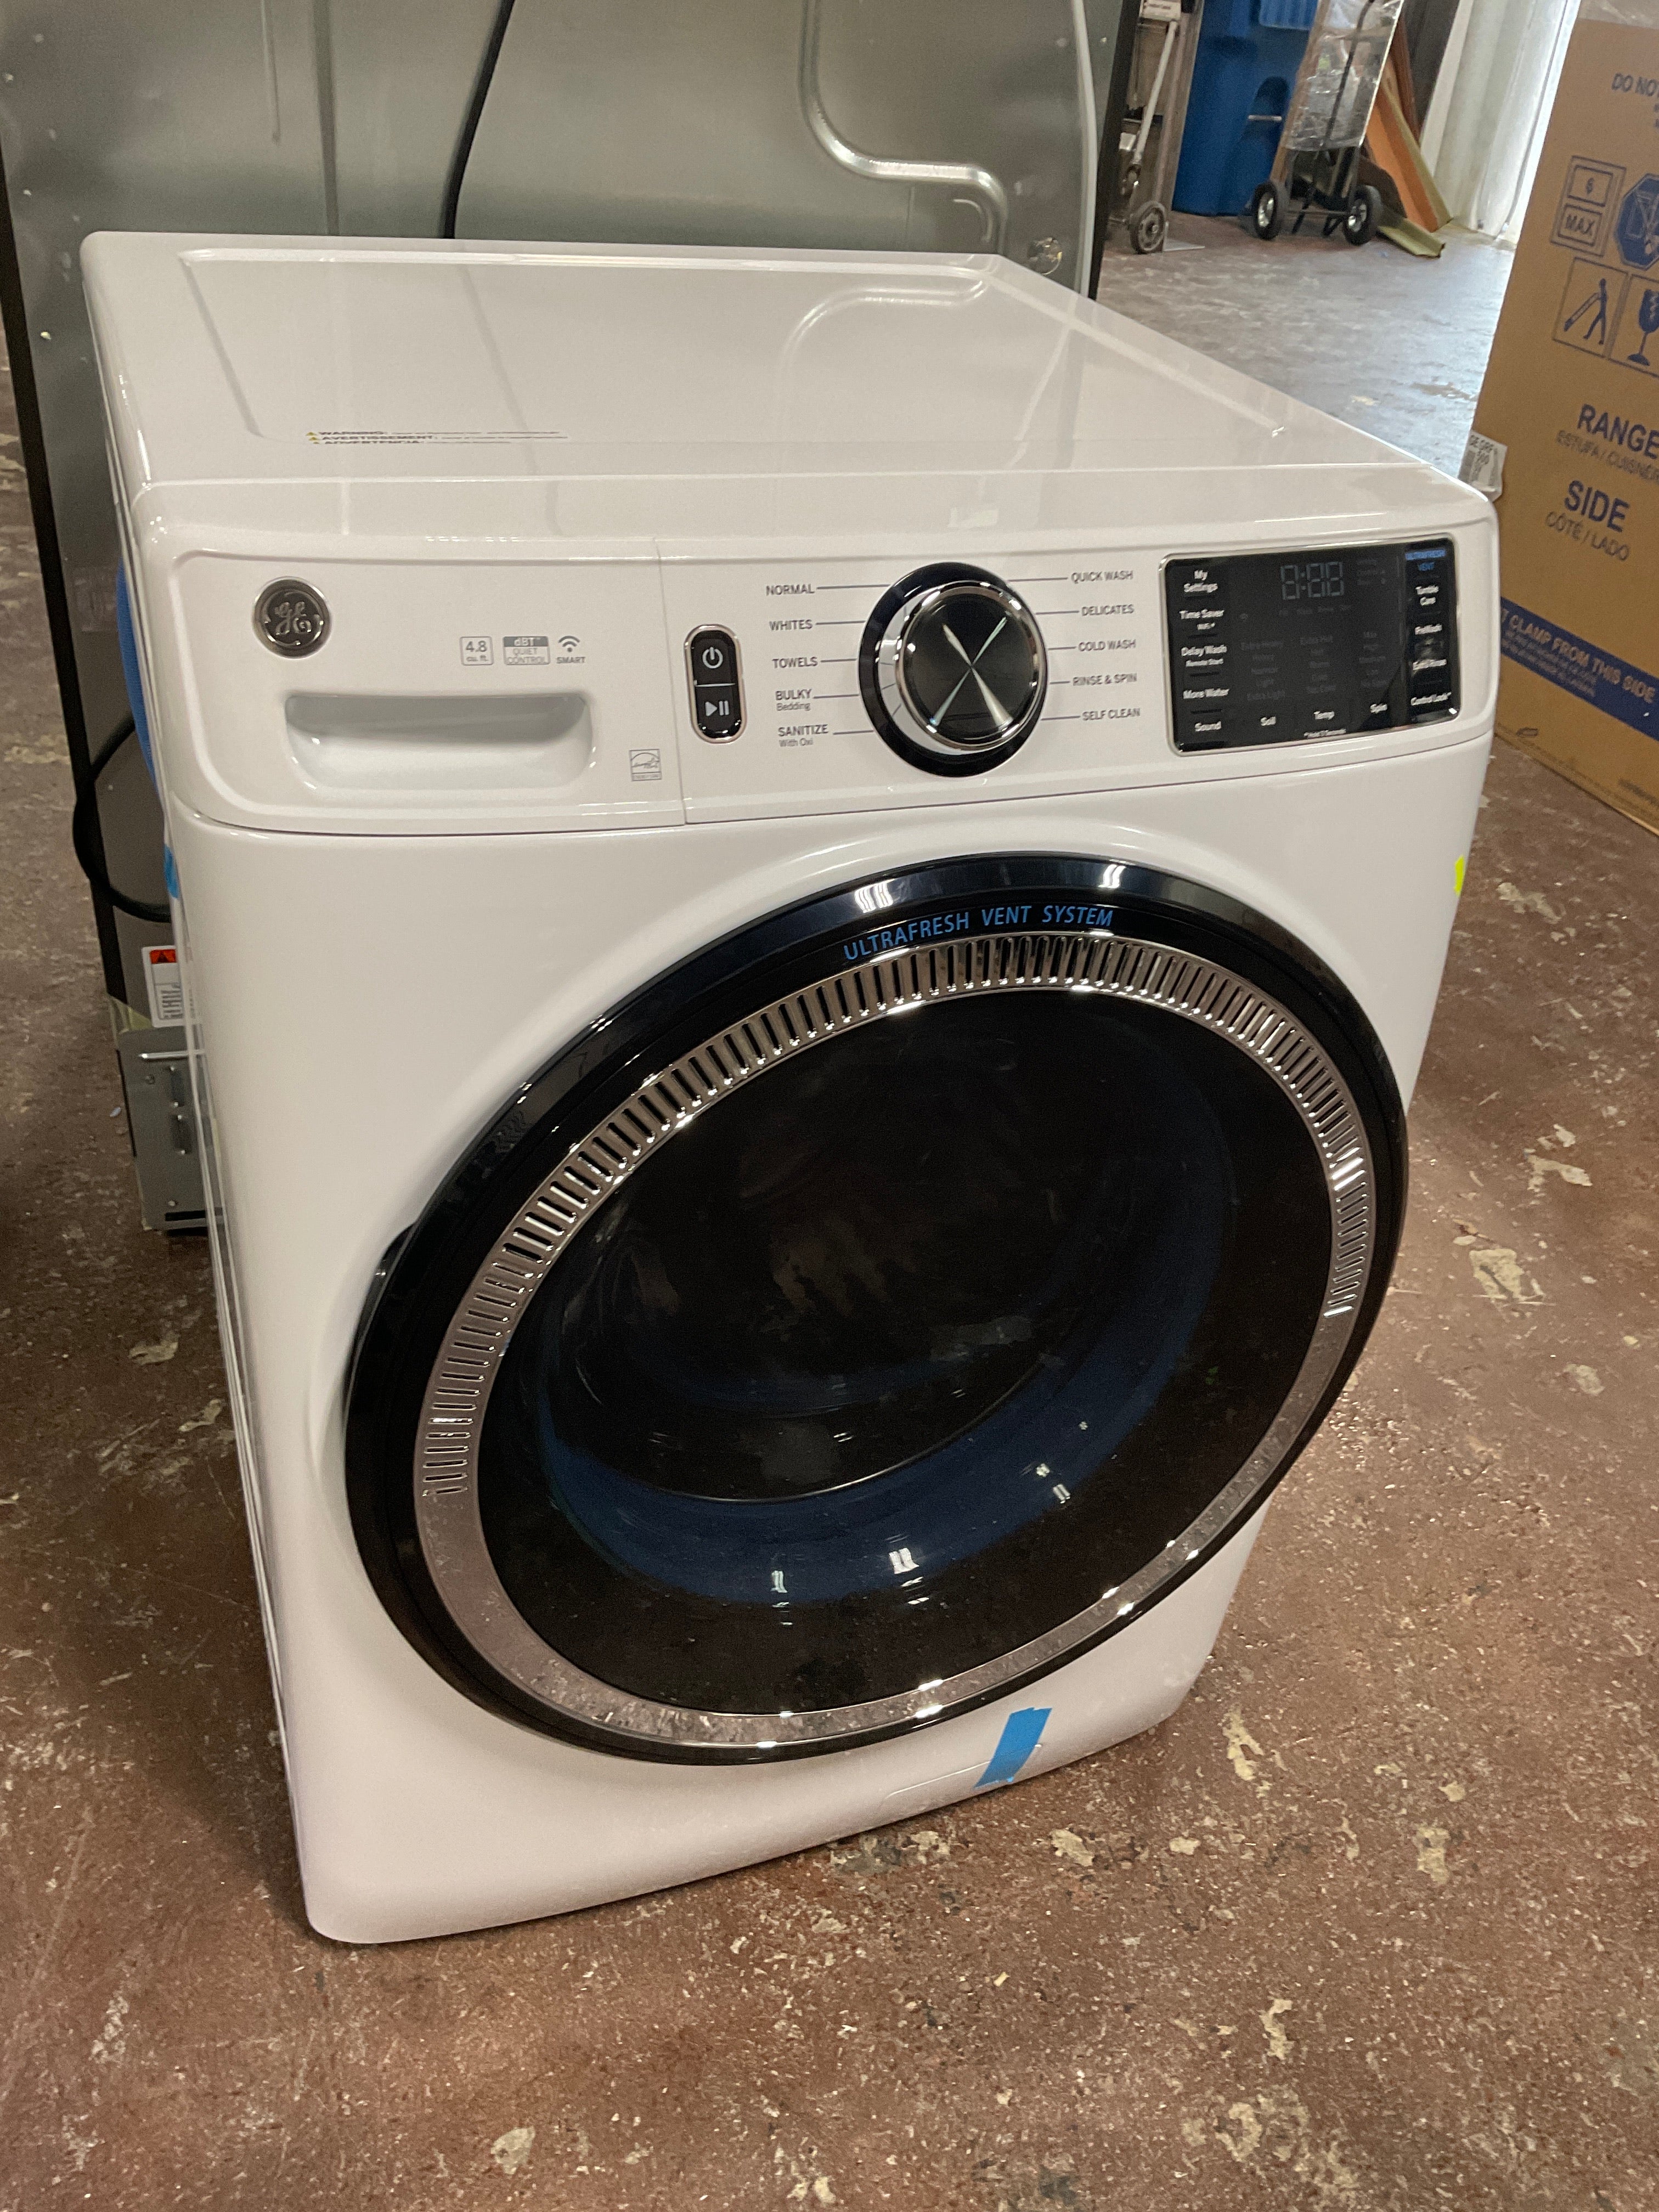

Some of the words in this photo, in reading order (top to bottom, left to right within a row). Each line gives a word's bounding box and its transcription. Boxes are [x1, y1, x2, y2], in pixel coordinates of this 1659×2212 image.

[1611, 72, 1633, 93] DO
[1635, 76, 1659, 97] NO
[1565, 213, 1595, 236] MAX
[1576, 403, 1659, 460] RANGE
[1564, 479, 1630, 533] SIDE
[1590, 531, 1631, 561] LADO
[1071, 571, 1103, 584] QUICK
[1104, 569, 1134, 582] WASH
[766, 583, 815, 596] NORMAL
[1081, 603, 1135, 617] DELICATES
[769, 619, 813, 631] WHITES
[465, 640, 488, 653] 4.8
[512, 647, 538, 656] QUIET
[1078, 641, 1105, 652] COLD
[1107, 639, 1137, 650] WASH
[507, 656, 548, 664] CONTROL
[556, 656, 586, 664] SMART
[771, 656, 819, 669] TOWELS
[1509, 614, 1552, 645] CLAMP
[1551, 636, 1590, 668] FROM
[1622, 675, 1656, 704] SIDE
[1073, 675, 1103, 686] RINSE
[1104, 674, 1113, 685] &
[1114, 673, 1137, 684] SPIN
[775, 688, 812, 701] BULKY
[776, 701, 811, 712] Bedding
[1082, 710, 1107, 721] SELF
[1107, 707, 1141, 720] CLEAN
[778, 723, 828, 737] SANITIZE
[843, 912, 969, 961] ULTRAFRESH
[981, 905, 1032, 927] VENT
[1042, 905, 1114, 927] SYSTEM
